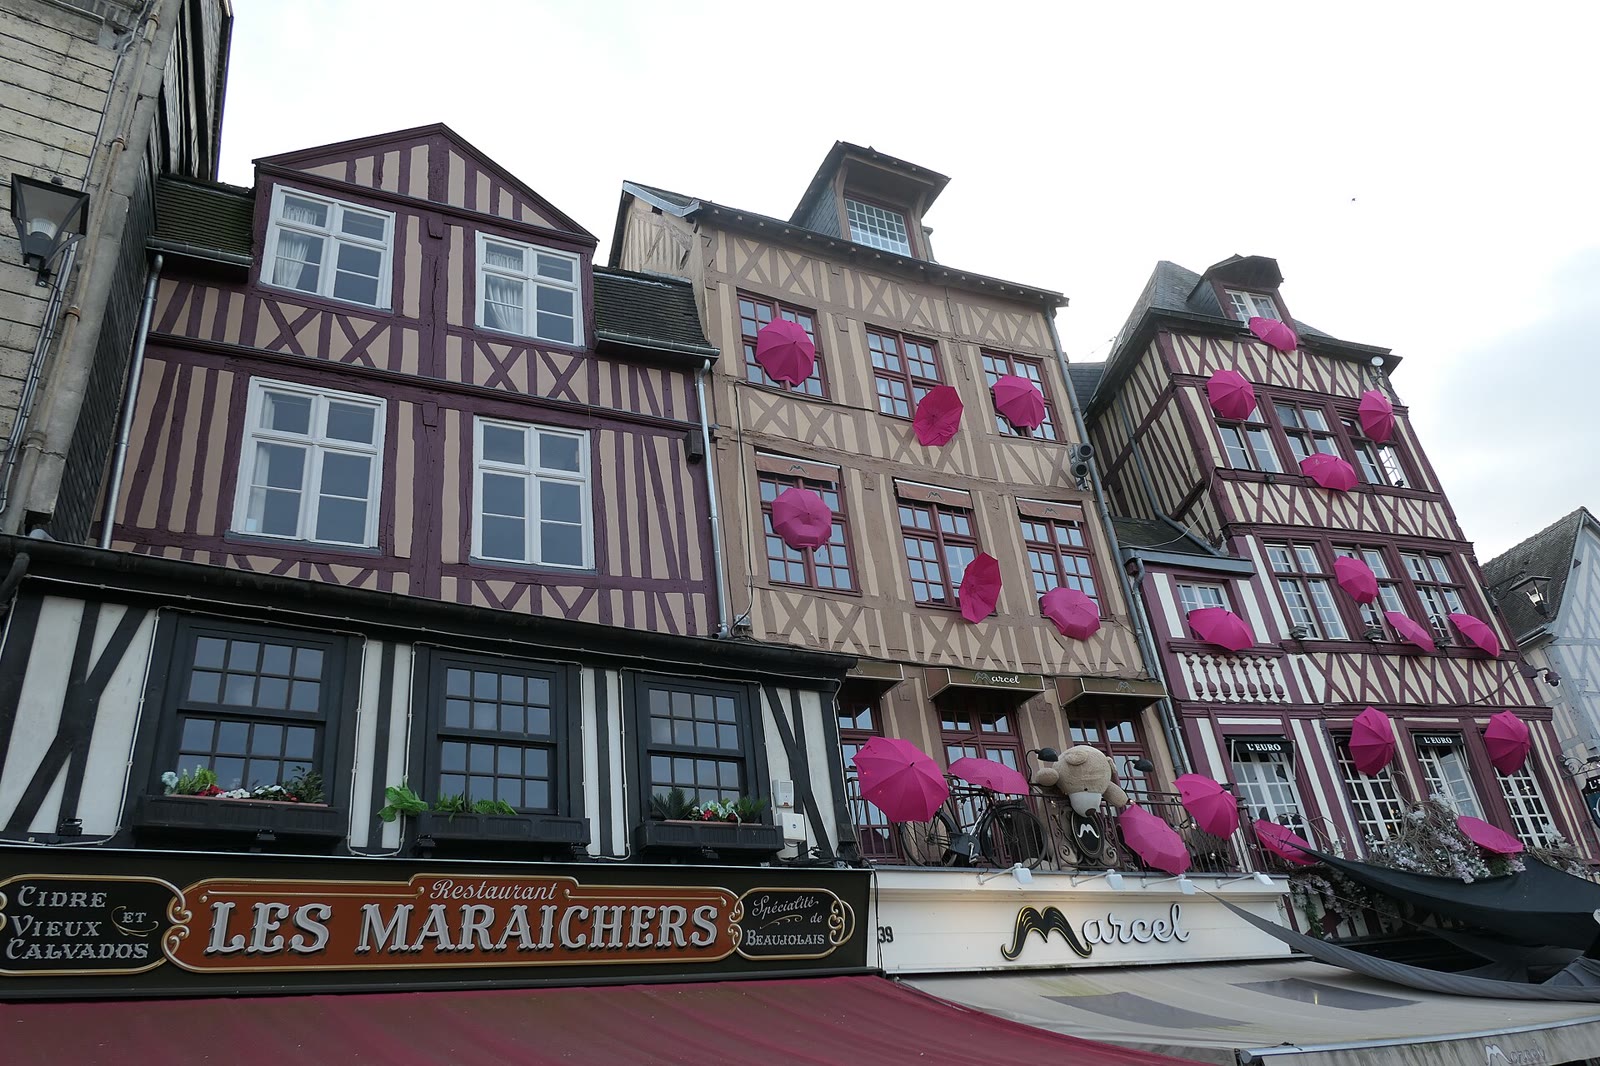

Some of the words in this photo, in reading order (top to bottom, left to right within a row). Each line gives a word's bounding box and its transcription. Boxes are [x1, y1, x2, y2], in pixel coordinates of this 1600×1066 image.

[971, 671, 1020, 685] Marcel
[1246, 743, 1282, 752] L'EURO
[1423, 736, 1453, 745] L'EURO
[17, 885, 107, 908] CIDRE
[429, 879, 558, 901] Restaurant
[751, 895, 819, 920] Spécialité
[10, 914, 102, 937] VIEUX
[121, 912, 147, 924] ET
[810, 912, 823, 924] de
[203, 902, 333, 956] LES
[355, 903, 719, 952] MARAICHERS
[745, 929, 825, 946] BEAUJOLAIS
[877, 925, 894, 943] 39
[1000, 903, 1191, 961] Marcel
[5, 937, 149, 960] CALVADOS
